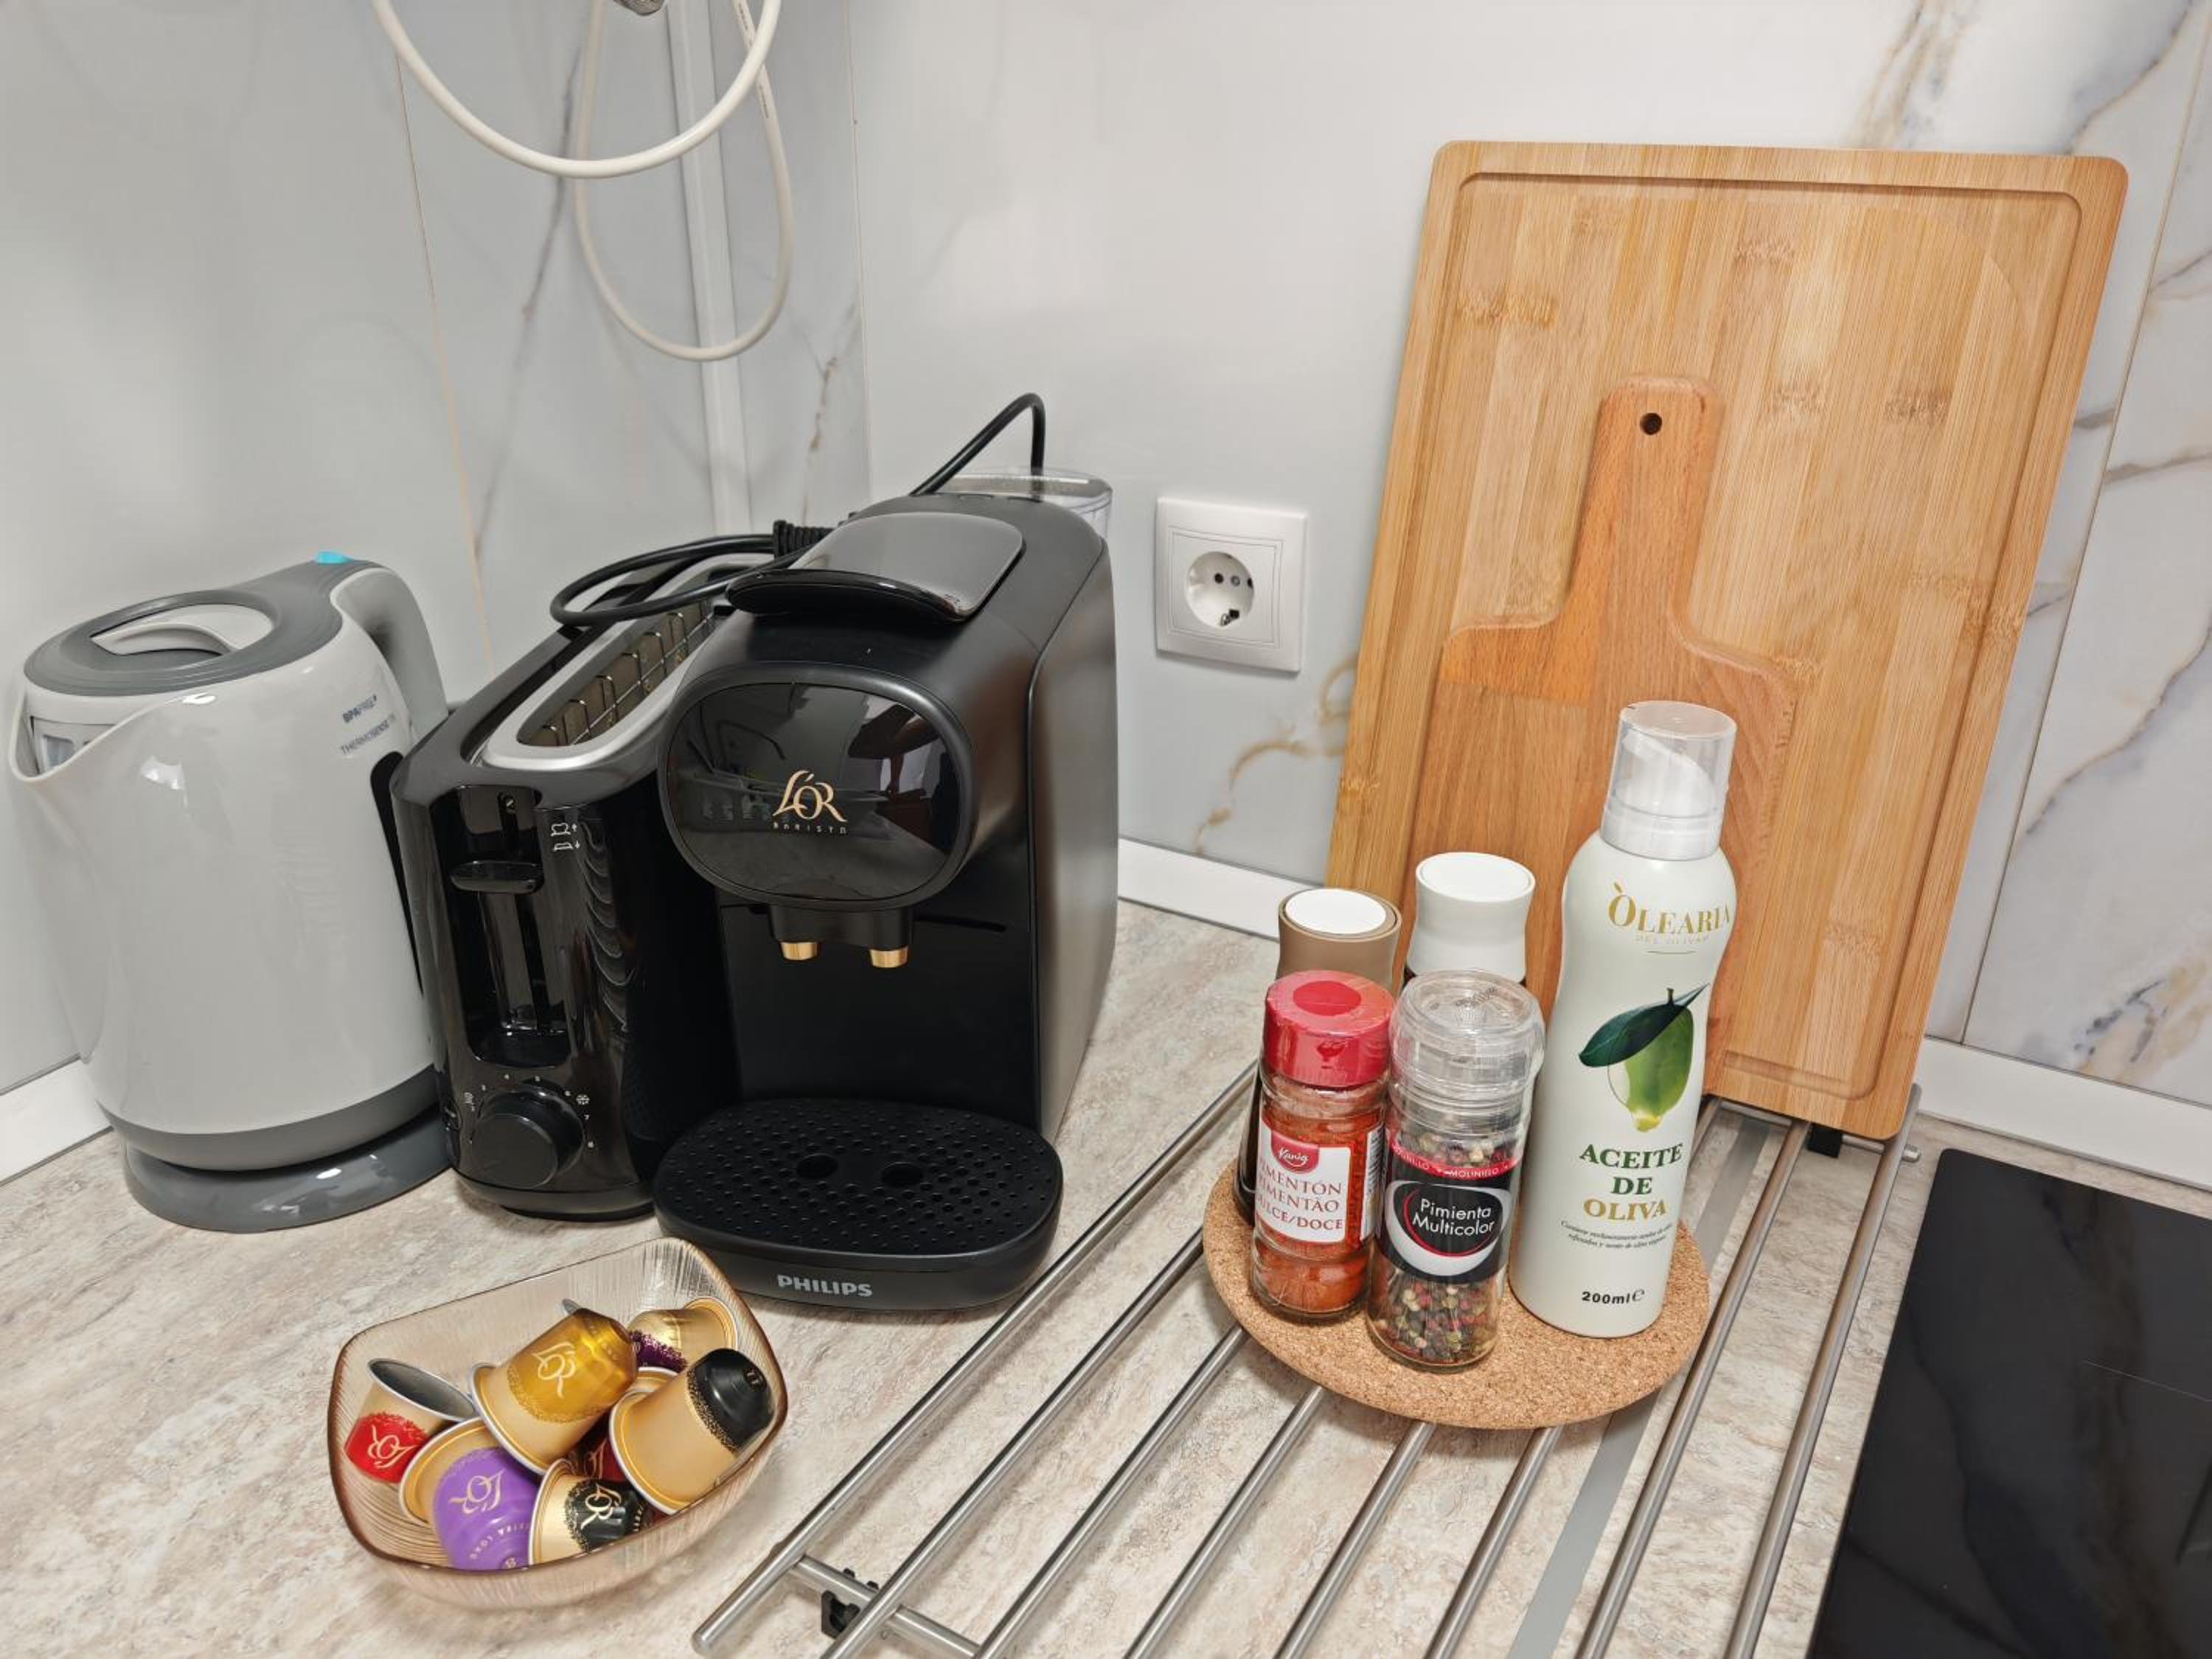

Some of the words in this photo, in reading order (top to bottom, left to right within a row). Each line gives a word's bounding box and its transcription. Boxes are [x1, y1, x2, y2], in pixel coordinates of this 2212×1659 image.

[772, 771, 848, 822] L'OR
[1579, 1143, 1683, 1169] ACEITE
[1610, 1176, 1653, 1195] DE
[1420, 1198, 1492, 1220] Pimienta
[1583, 1198, 1666, 1221] OLIVA
[1412, 1212, 1495, 1237] Multicolor
[777, 1274, 873, 1297] PHILIPS
[1582, 1290, 1630, 1304] 200ml
